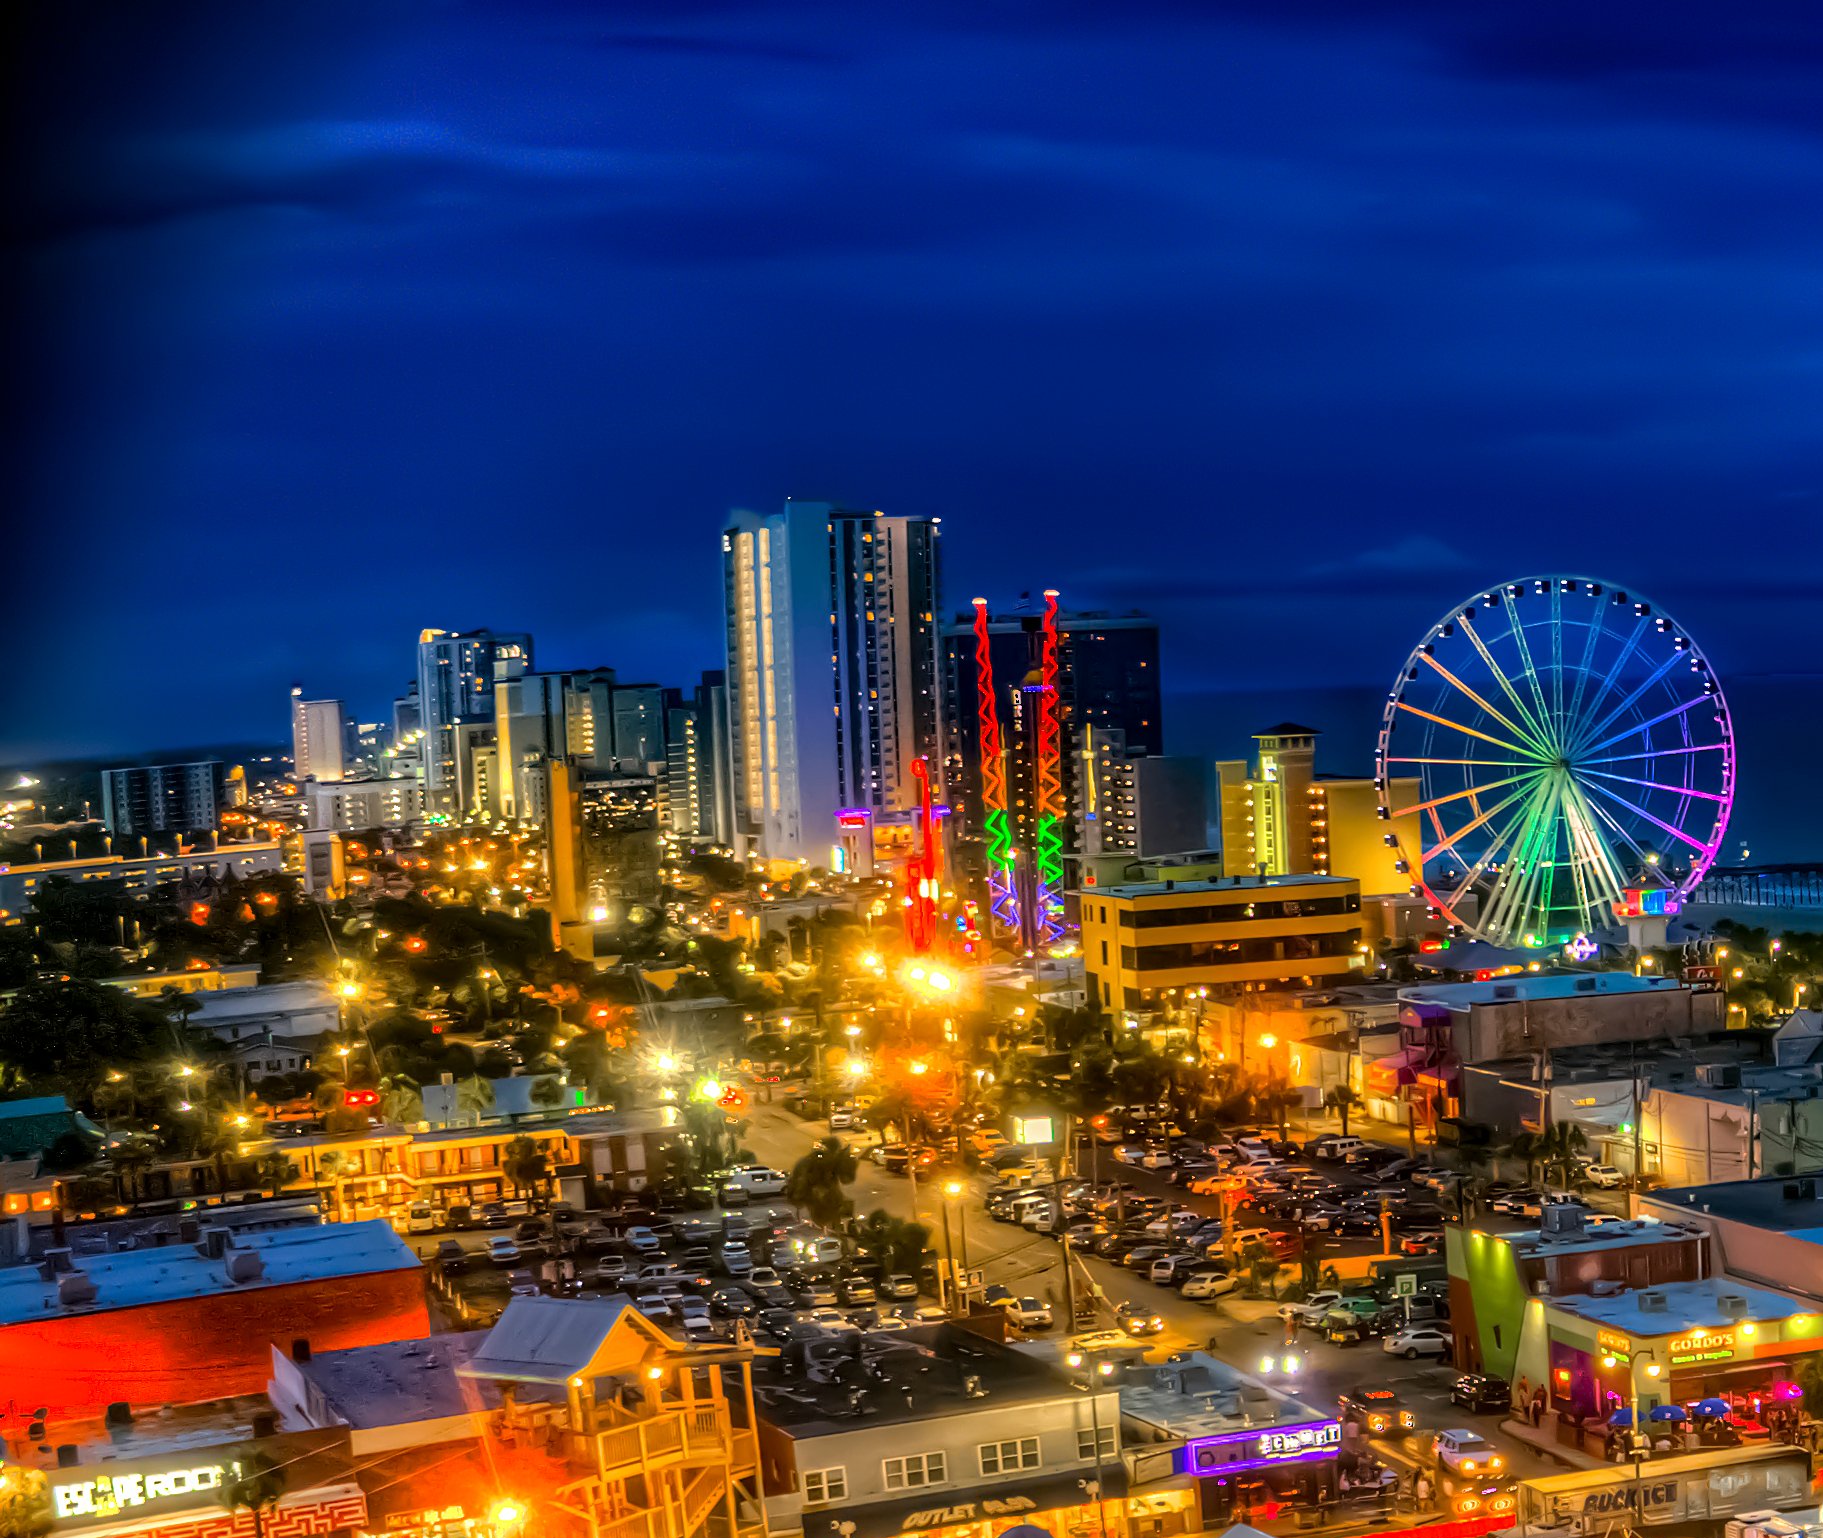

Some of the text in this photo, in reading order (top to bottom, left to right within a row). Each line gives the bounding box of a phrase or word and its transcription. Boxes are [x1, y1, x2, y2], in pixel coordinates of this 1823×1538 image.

[1670, 1333, 1734, 1352] GORDO'S
[54, 1474, 146, 1518] ESCAPE
[902, 1503, 977, 1530] OUTLET
